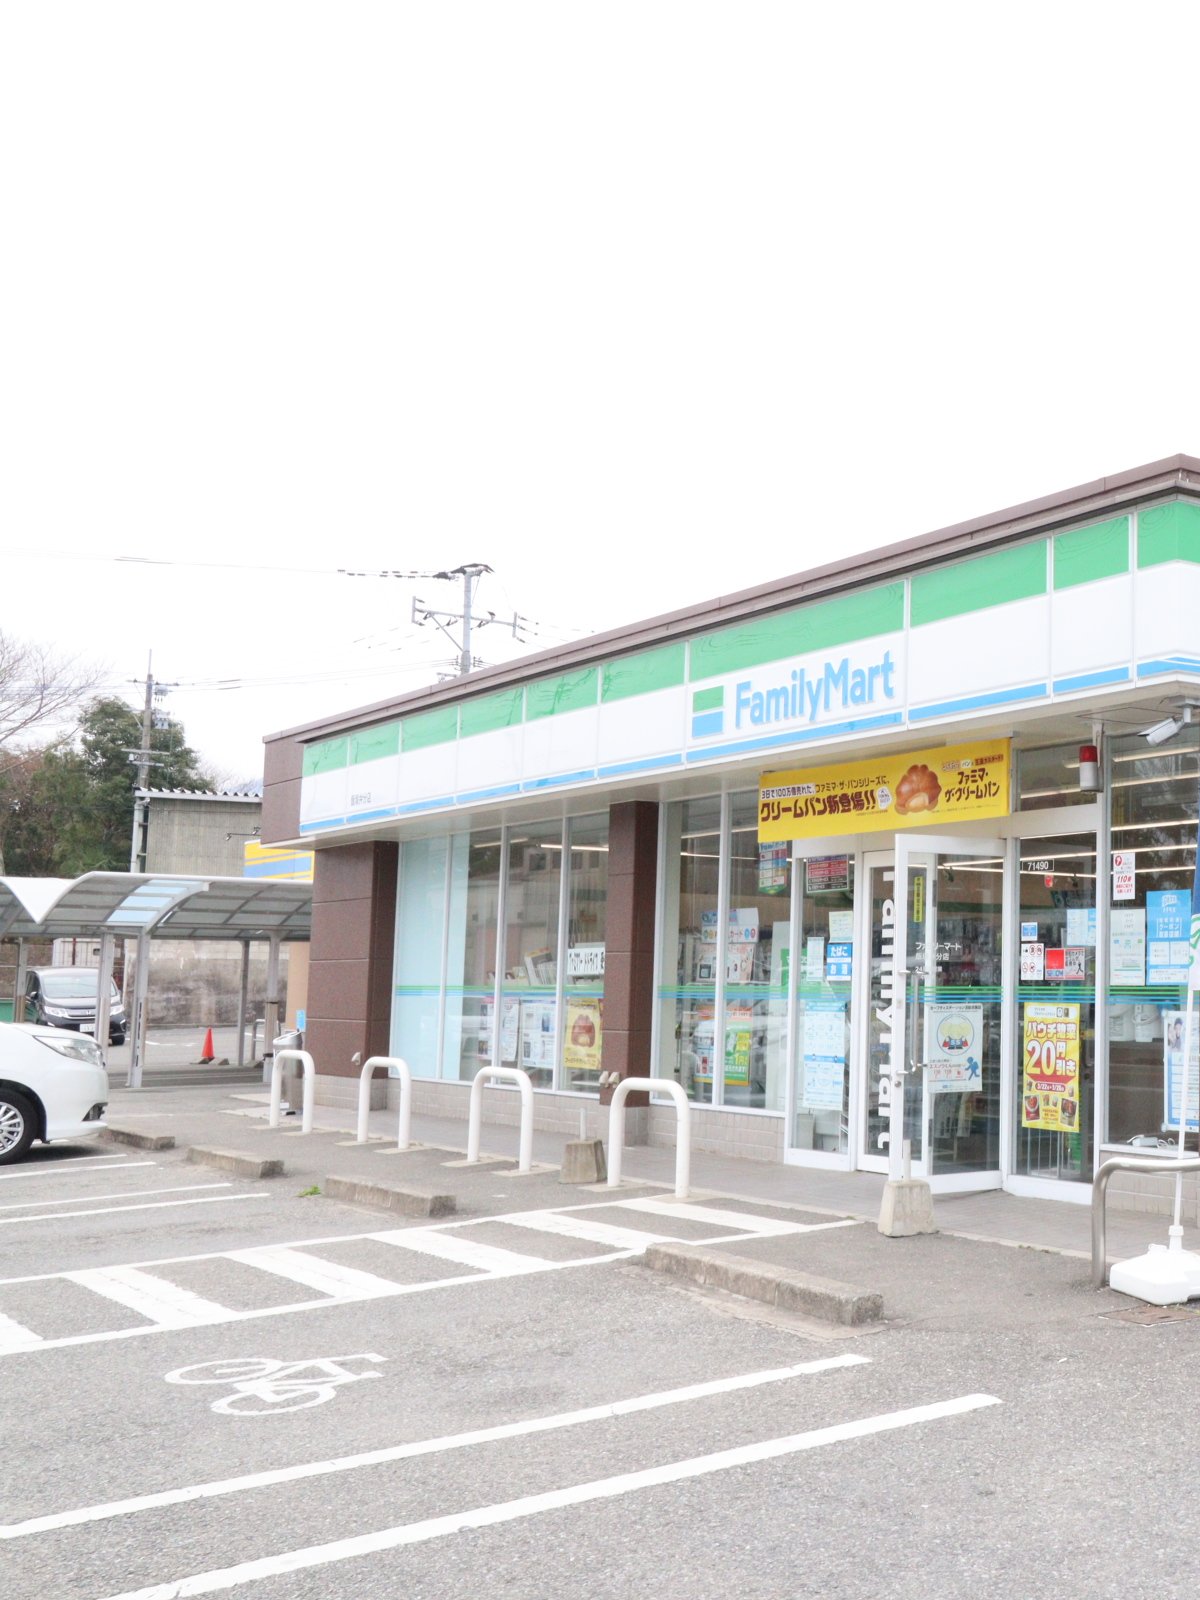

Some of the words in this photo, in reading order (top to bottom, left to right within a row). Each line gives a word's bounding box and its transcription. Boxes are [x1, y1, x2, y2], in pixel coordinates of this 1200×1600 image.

[735, 650, 895, 729] FamilyMart
[945, 781, 1000, 802] ザ・クリームパン
[760, 788, 876, 822] クリームパン新登場!!
[1027, 861, 1049, 871] 71490
[830, 946, 848, 957] たばこ
[915, 942, 962, 950] フーマート
[915, 952, 950, 960] 飯分店
[1026, 1039, 1056, 1076] 20
